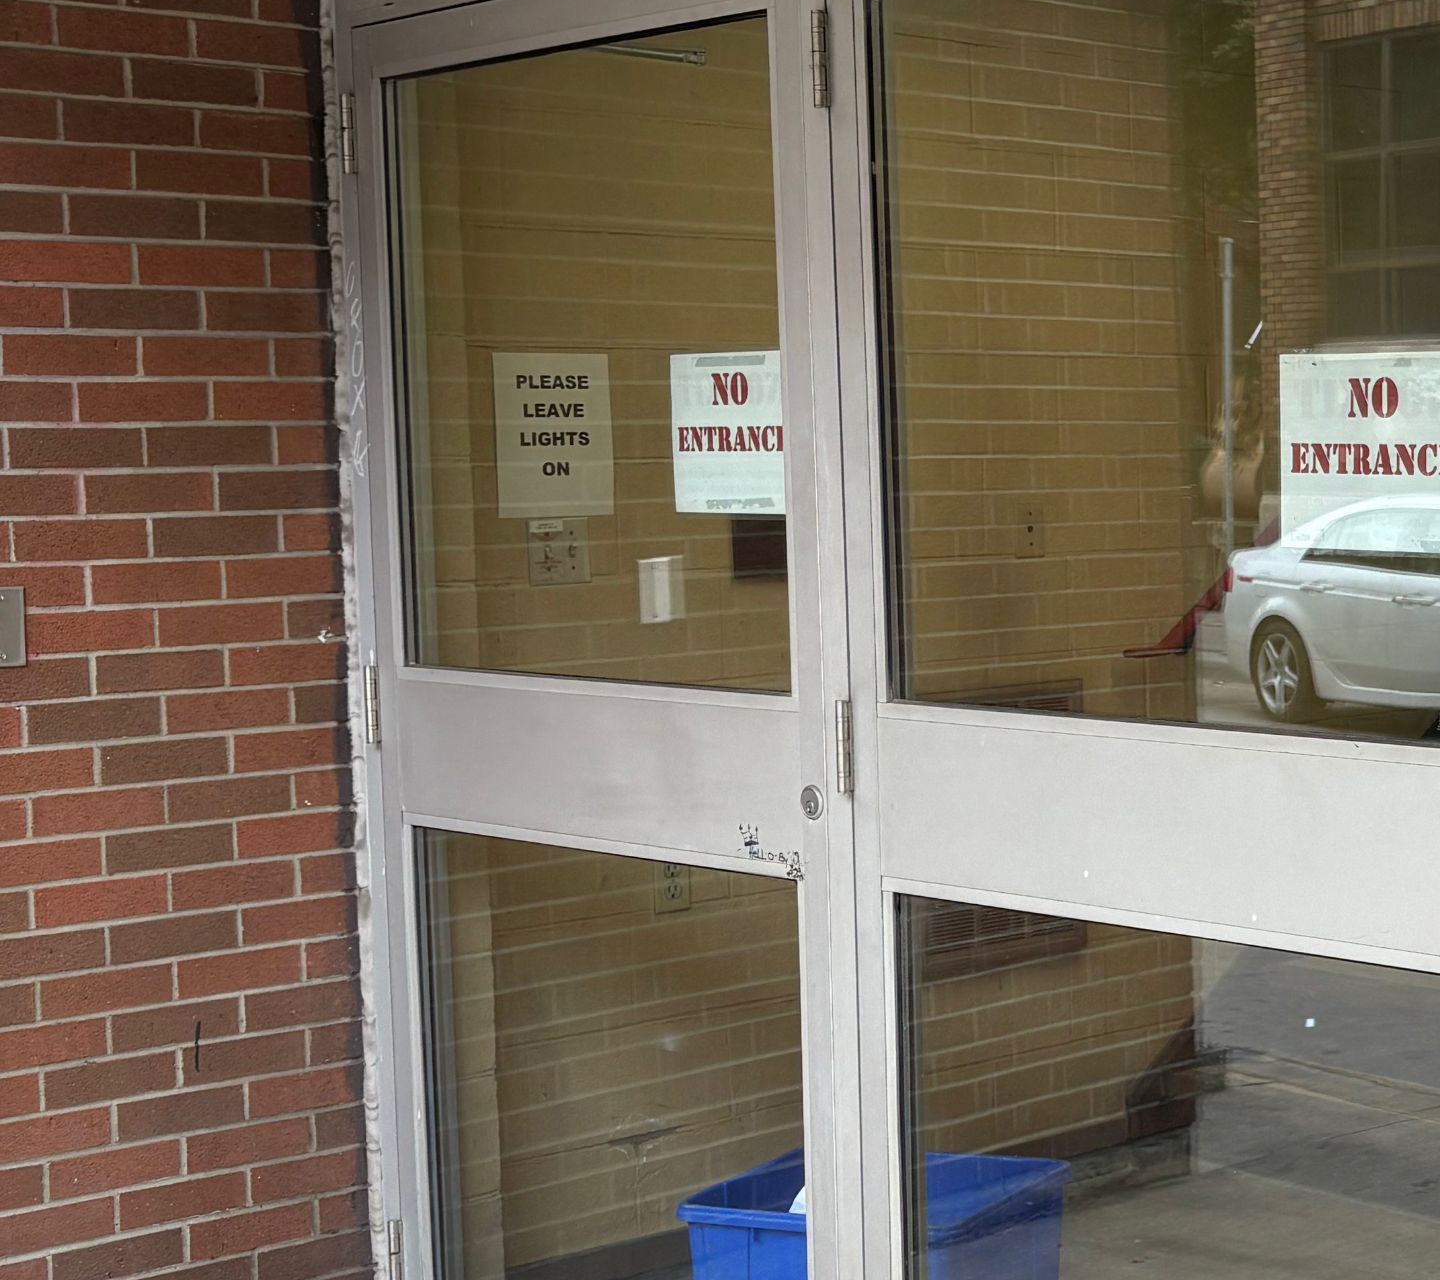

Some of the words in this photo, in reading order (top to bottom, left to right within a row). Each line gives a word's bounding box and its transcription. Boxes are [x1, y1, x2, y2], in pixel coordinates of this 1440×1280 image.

[516, 374, 589, 390] PLEASE
[711, 371, 749, 406] NO
[1348, 376, 1399, 418] NO
[523, 403, 585, 418] LEAVE
[520, 431, 590, 447] LIGHTS
[542, 461, 570, 476] ON
